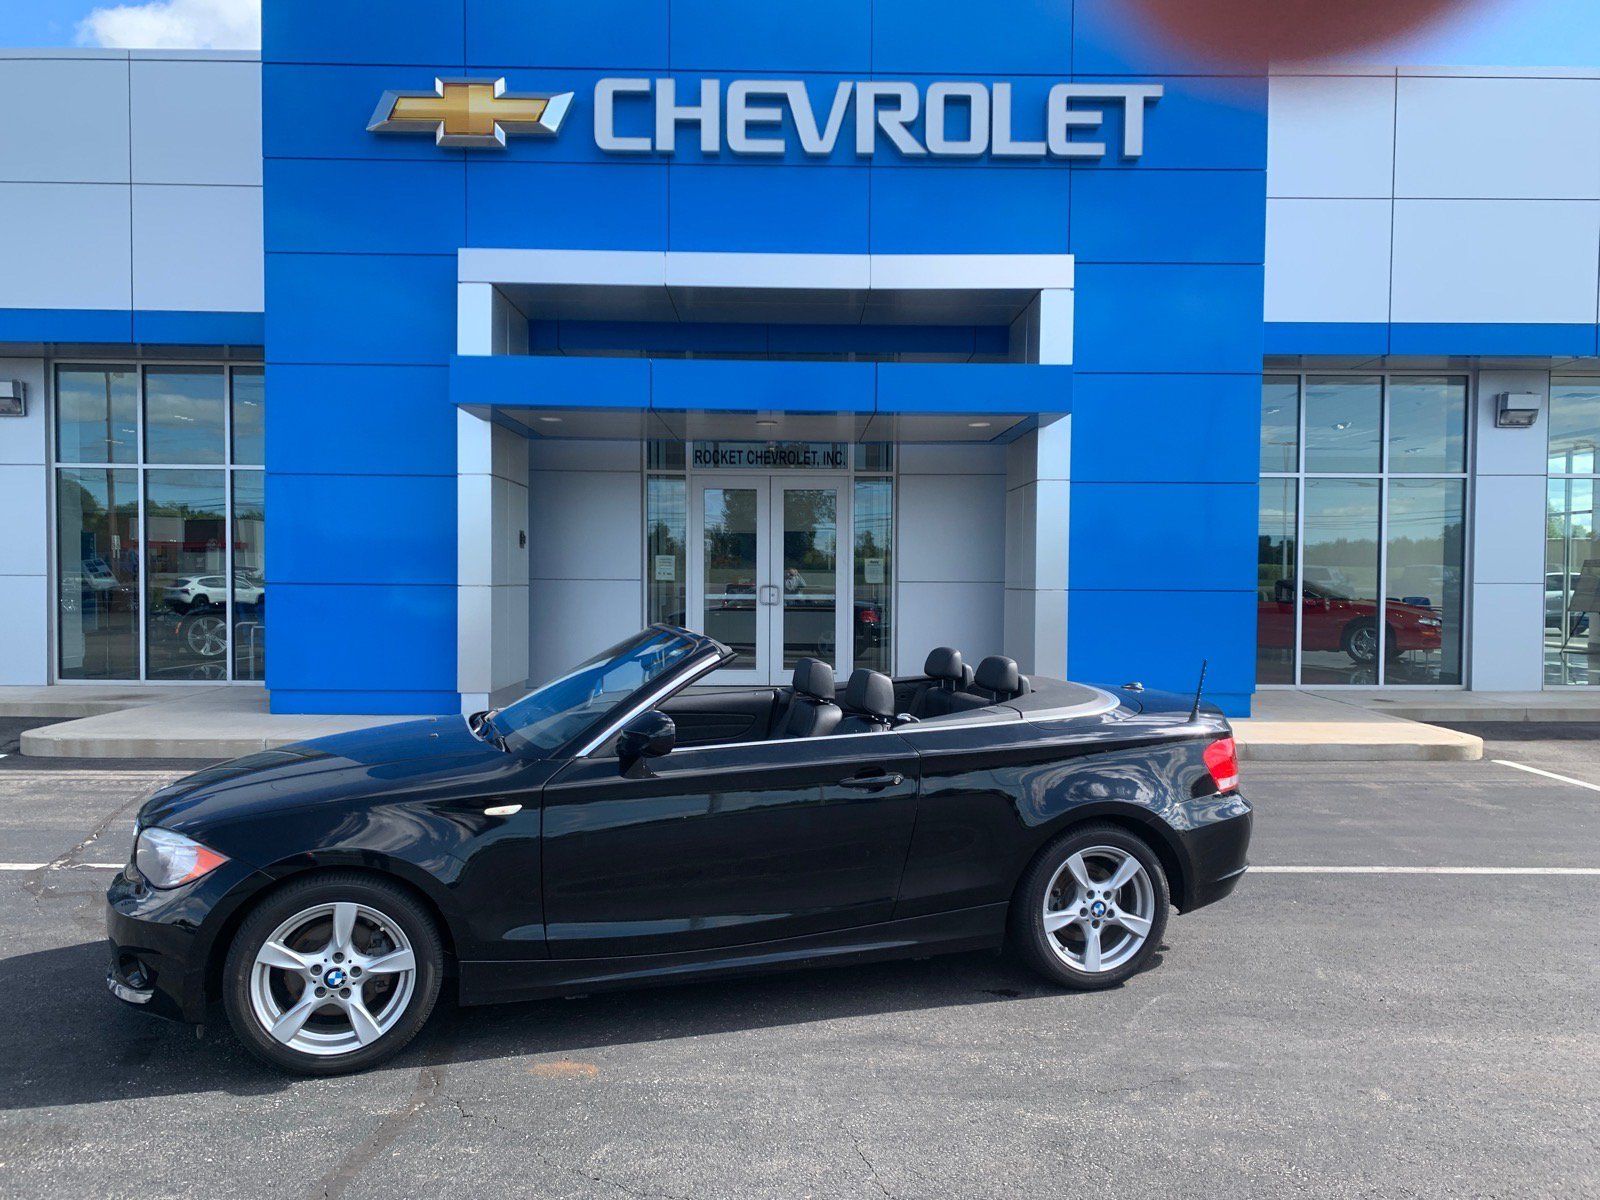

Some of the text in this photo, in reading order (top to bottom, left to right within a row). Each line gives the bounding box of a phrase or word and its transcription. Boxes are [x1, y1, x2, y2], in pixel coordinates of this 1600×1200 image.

[594, 78, 1164, 157] CHEVROLET
[694, 449, 846, 466] ROCKET CHEVROLET, INC.
